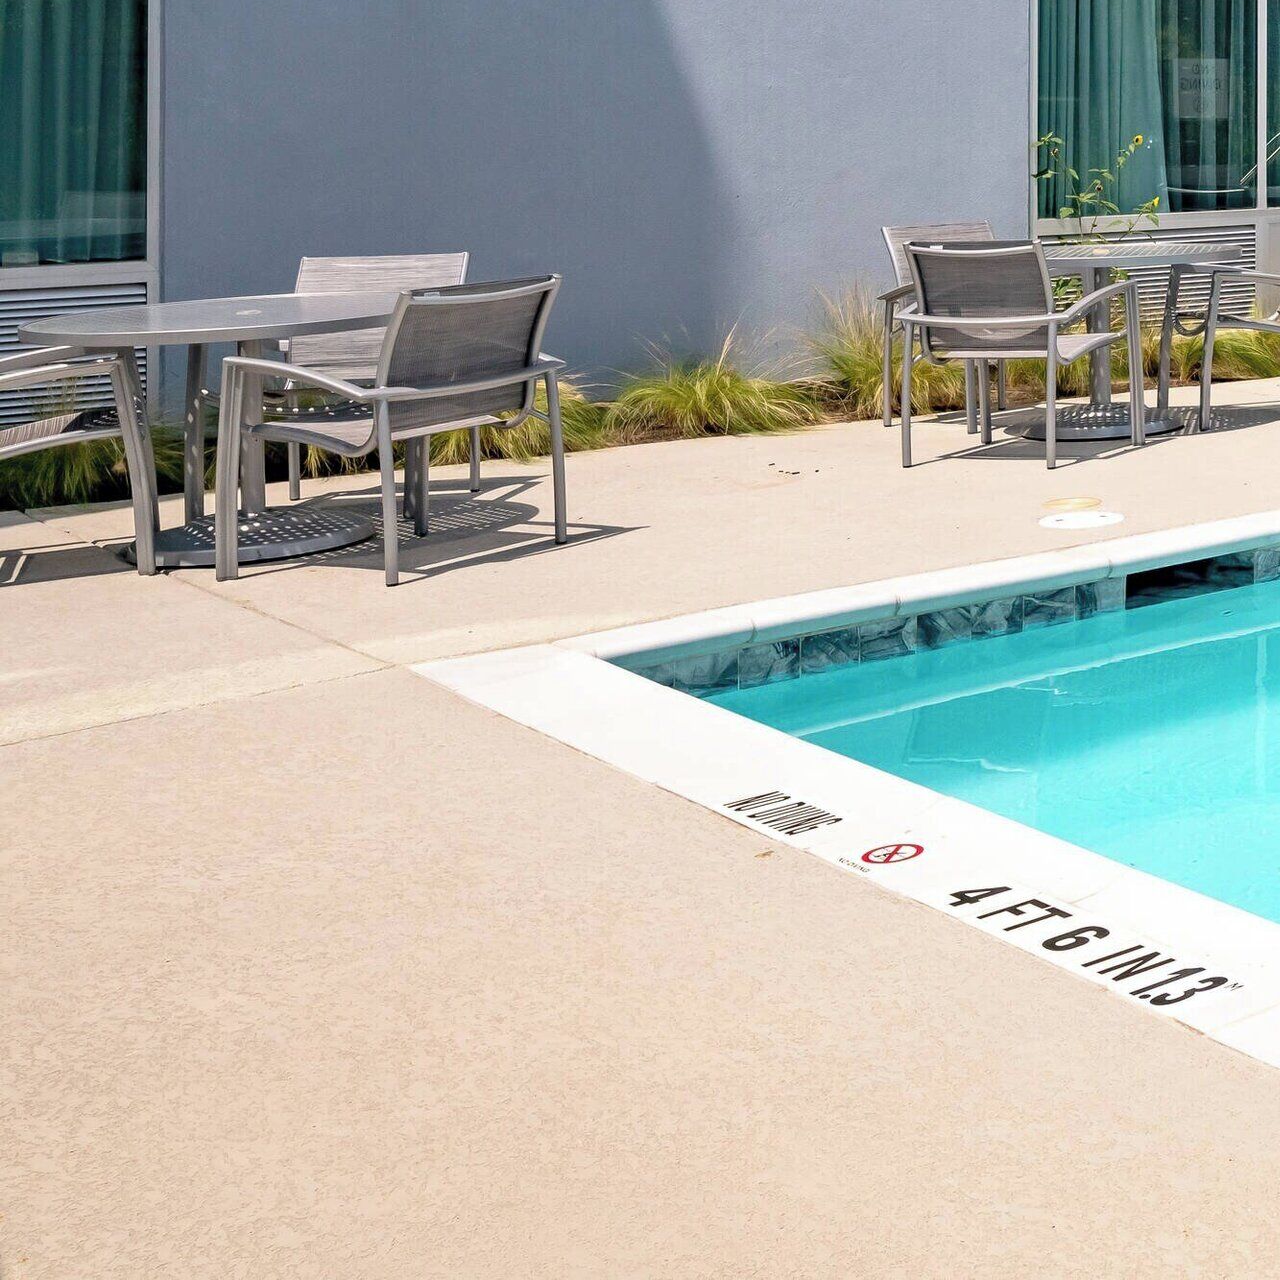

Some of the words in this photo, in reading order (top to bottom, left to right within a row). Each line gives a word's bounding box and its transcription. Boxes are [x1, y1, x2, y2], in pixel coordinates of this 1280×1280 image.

[723, 790, 792, 812] NO
[746, 801, 844, 836] DIVING
[949, 885, 1013, 908] 4
[976, 898, 1074, 932] FT
[1041, 925, 1111, 952] 6
[1080, 943, 1176, 983] IN
